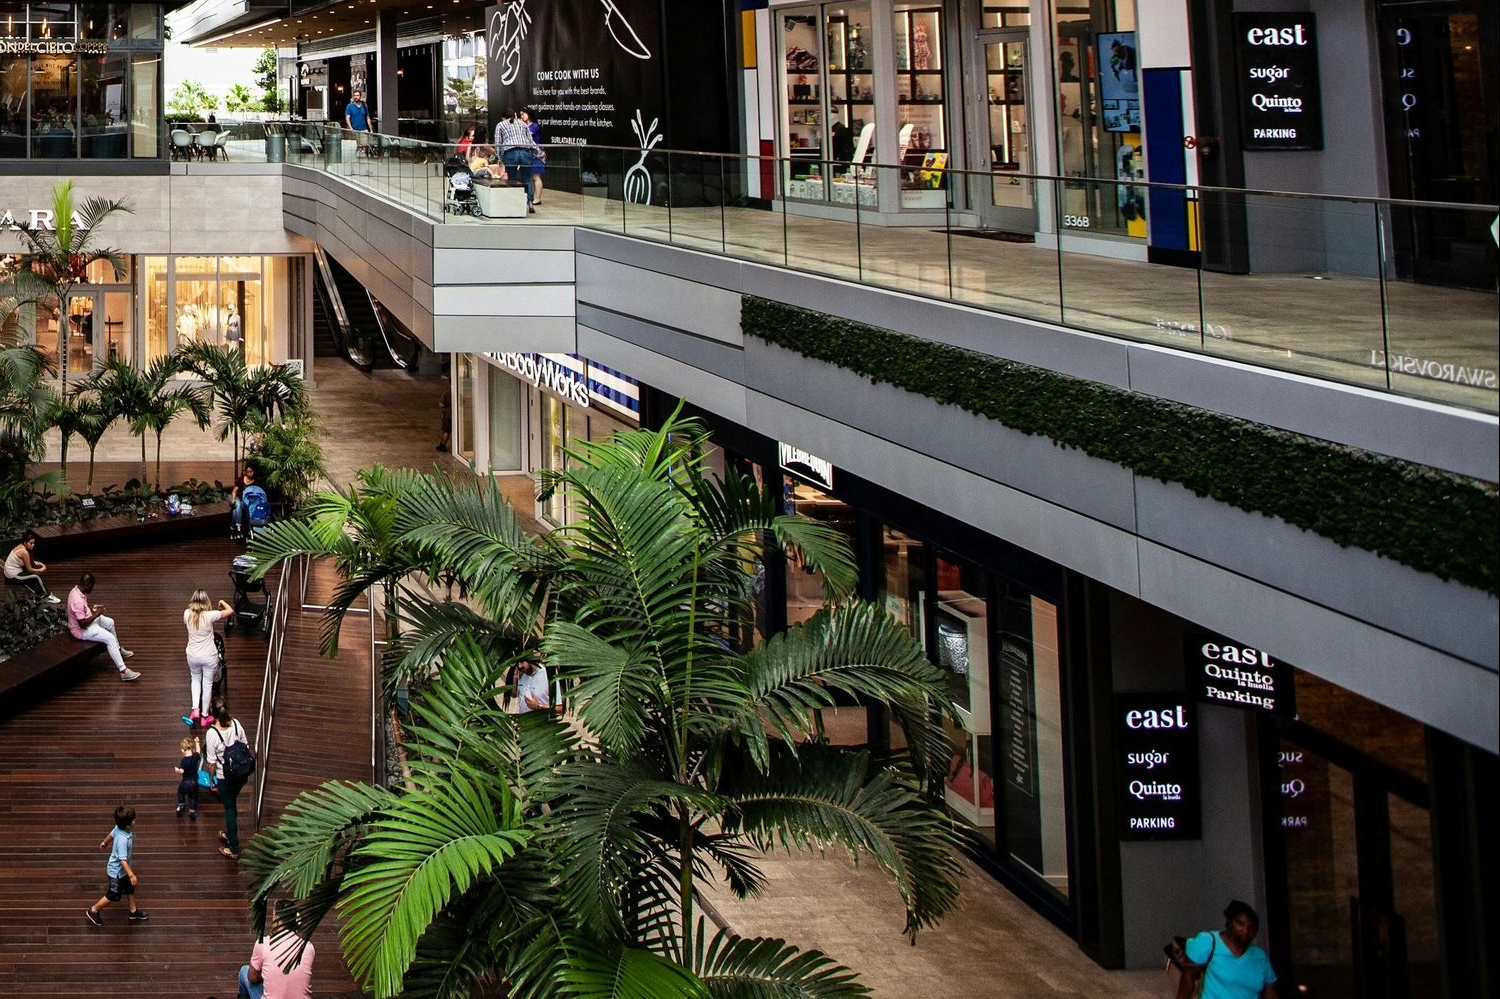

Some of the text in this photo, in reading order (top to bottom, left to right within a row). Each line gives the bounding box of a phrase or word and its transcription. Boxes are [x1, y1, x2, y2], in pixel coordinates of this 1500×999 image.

[1247, 24, 1308, 46] east
[36, 42, 75, 54] CIELO
[536, 68, 600, 81] COME COOK WITH US
[1249, 65, 1291, 83] sugar
[580, 85, 589, 95] best
[1251, 93, 1302, 112] Quinto
[1253, 128, 1297, 139] PARKING
[1064, 214, 1090, 228] 336B
[507, 352, 542, 388] Body
[542, 357, 590, 408] Works
[1201, 642, 1275, 668] east
[1204, 663, 1274, 685] Quinto
[1205, 686, 1275, 710] Parking
[1126, 705, 1188, 729] east
[1127, 750, 1169, 769] sugar
[1129, 780, 1181, 800] Quinto
[1130, 817, 1175, 829] PARKING
